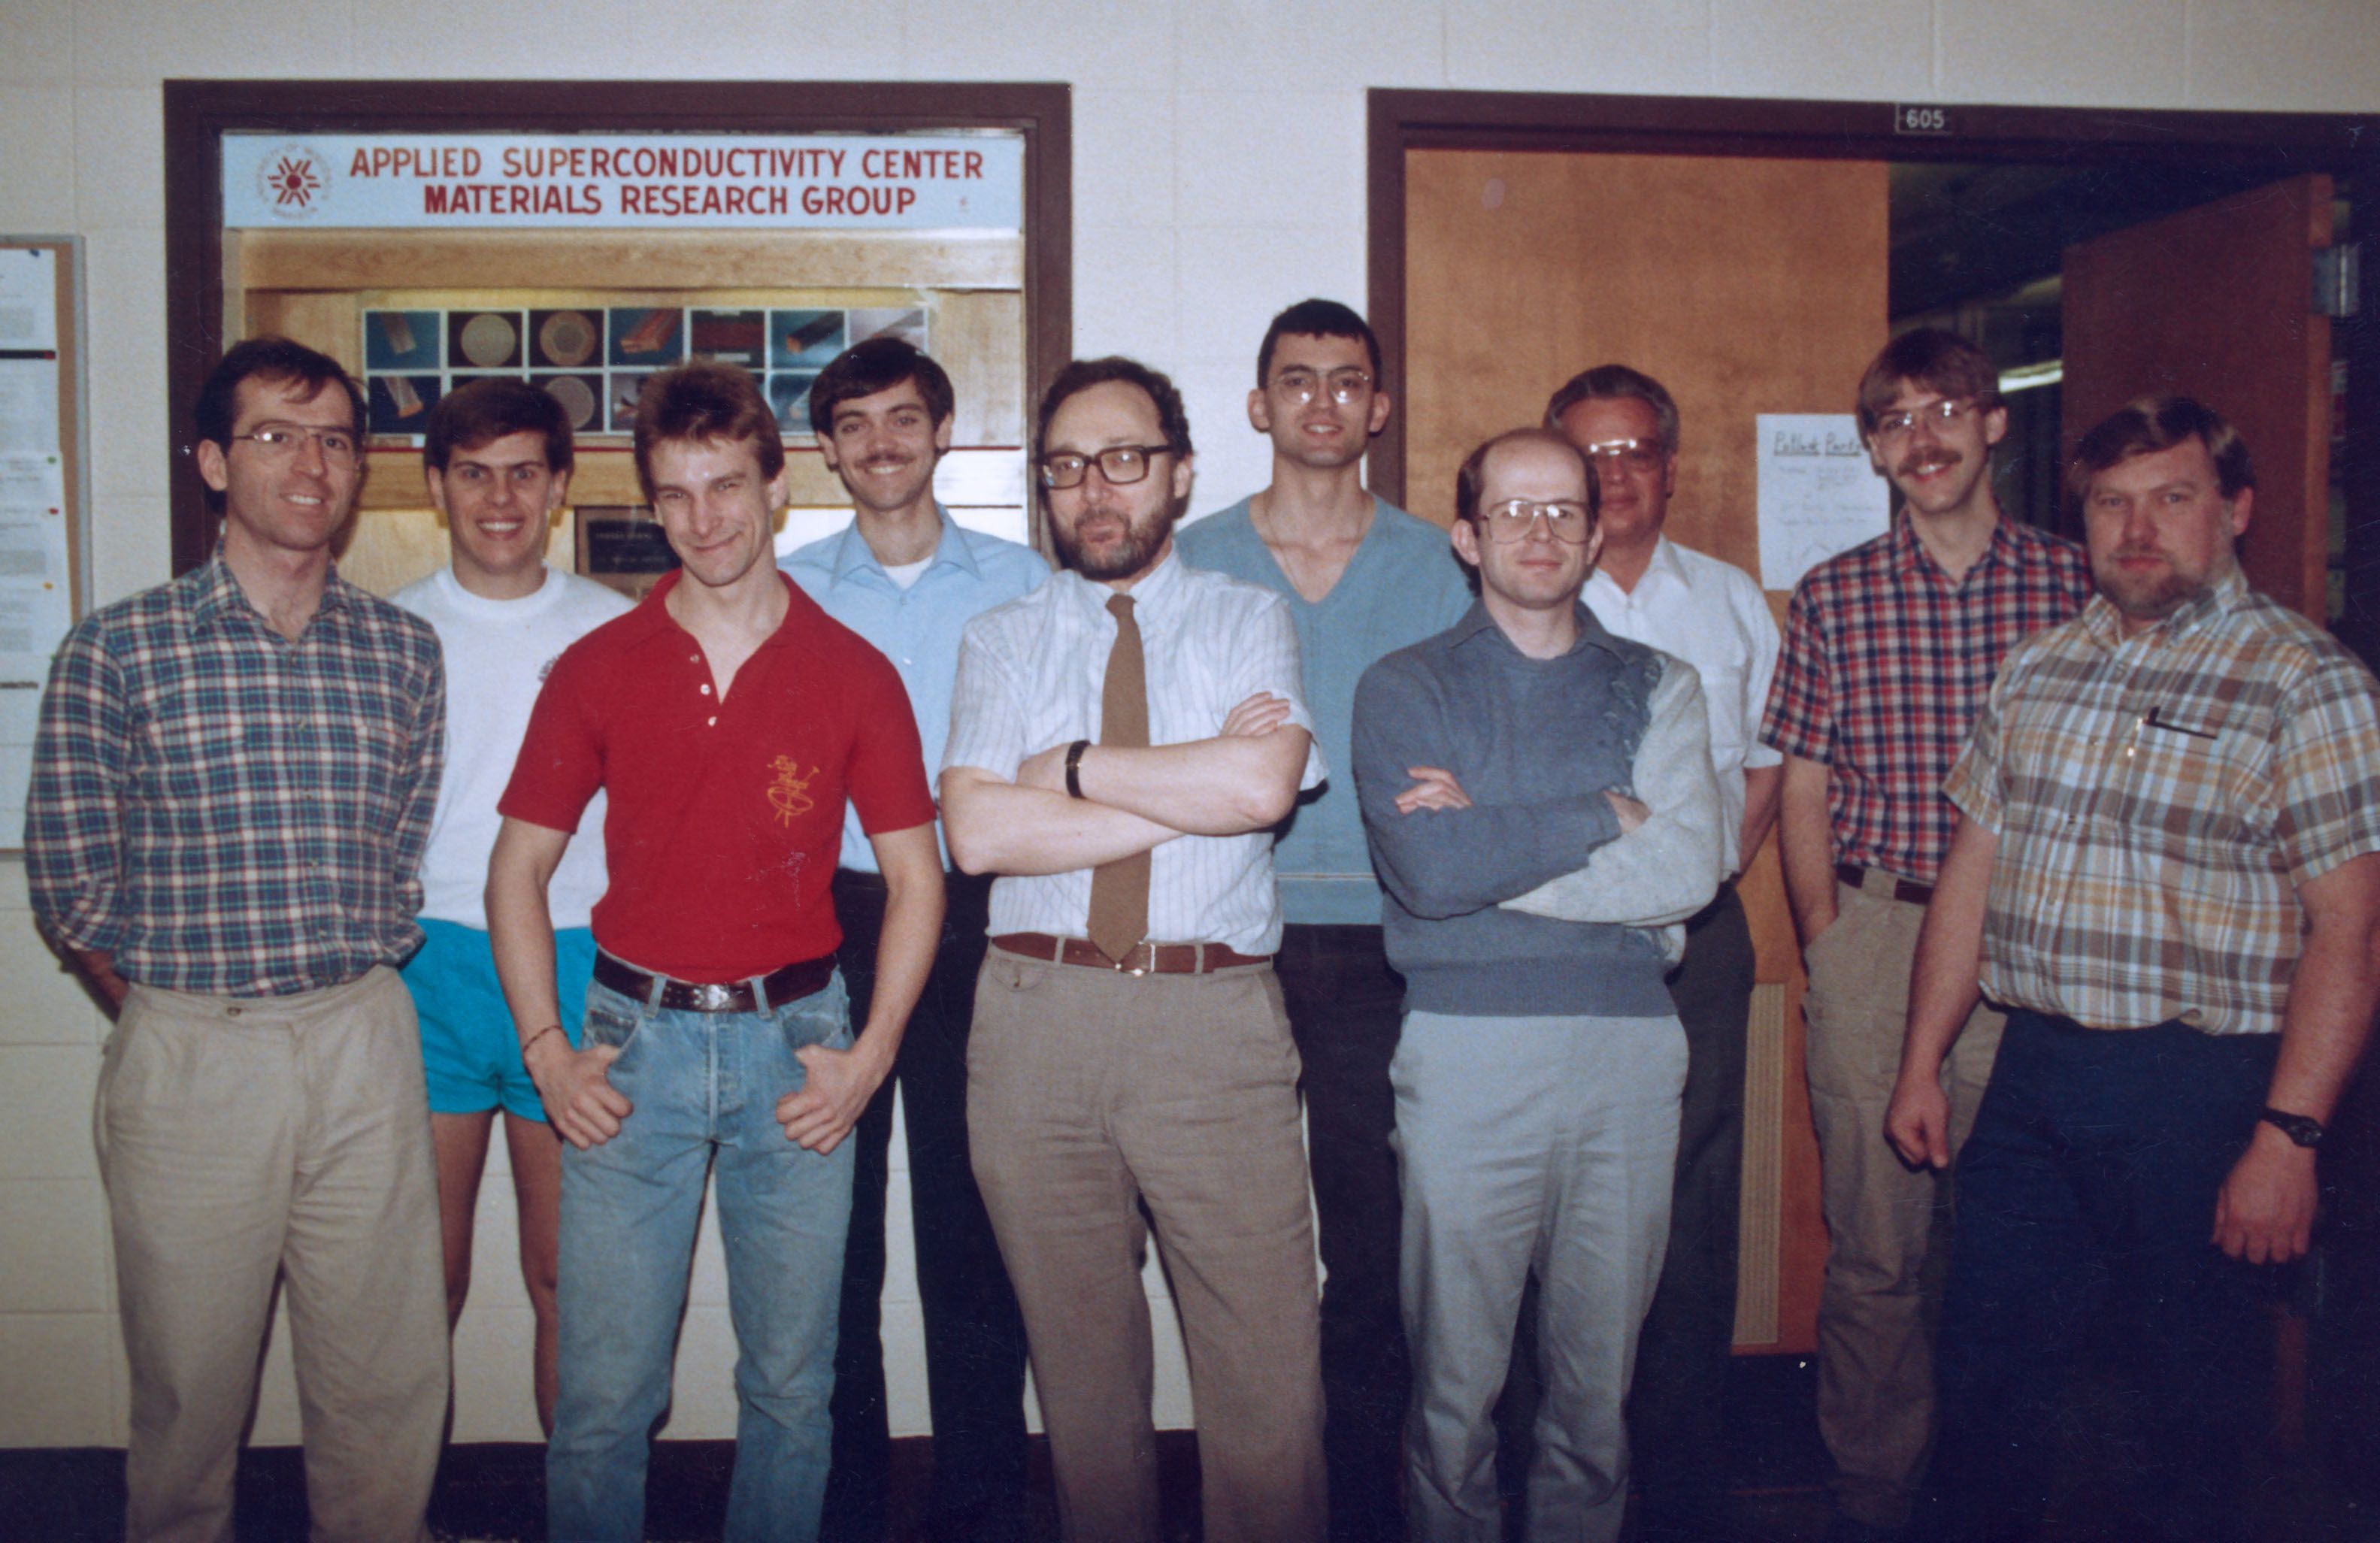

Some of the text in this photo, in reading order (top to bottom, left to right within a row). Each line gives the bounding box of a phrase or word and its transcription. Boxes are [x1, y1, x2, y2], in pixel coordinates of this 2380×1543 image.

[1906, 108, 1945, 129] 605
[350, 147, 983, 179] APPLIED SUPERCONDUCTIVITY CENTER
[424, 184, 916, 216] MATERIALS RESEARCH GROUP
